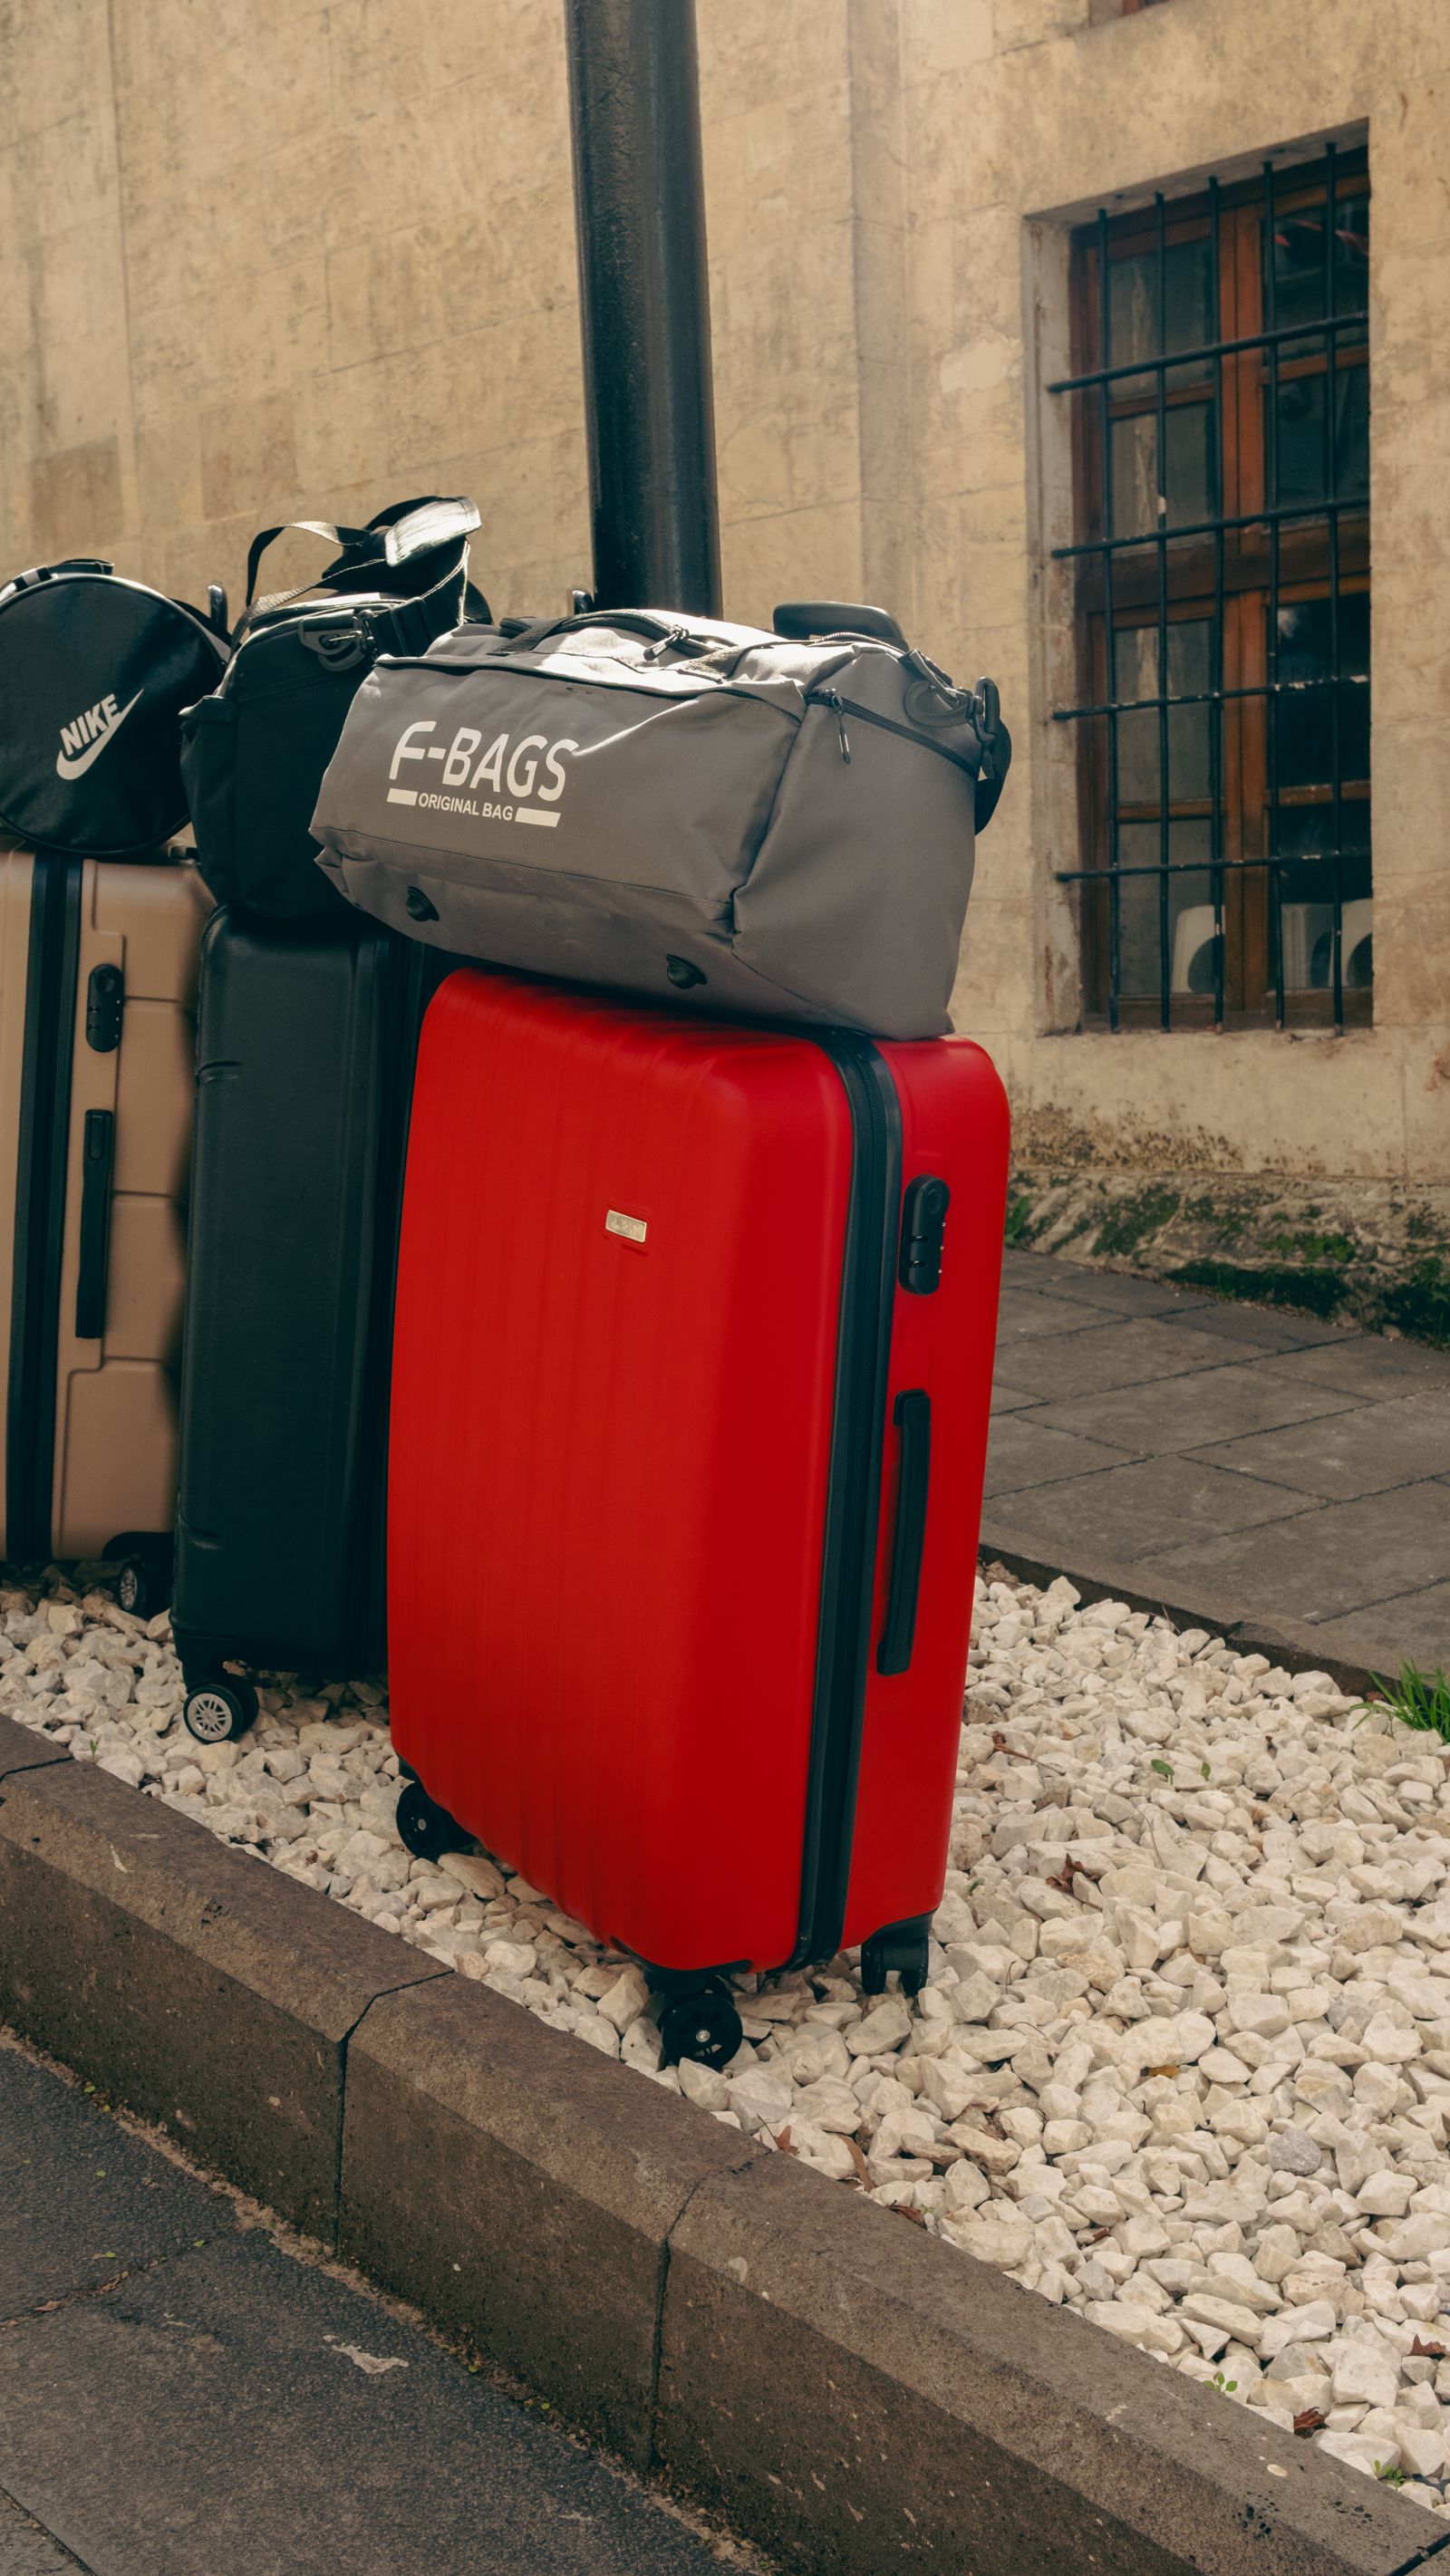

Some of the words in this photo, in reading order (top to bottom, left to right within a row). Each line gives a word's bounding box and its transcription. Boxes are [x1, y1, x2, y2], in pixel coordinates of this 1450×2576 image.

[60, 693, 121, 756] NIKE
[389, 721, 579, 802] F-BAGS
[418, 792, 479, 816] ORIGINAL
[482, 802, 514, 821] BAG
